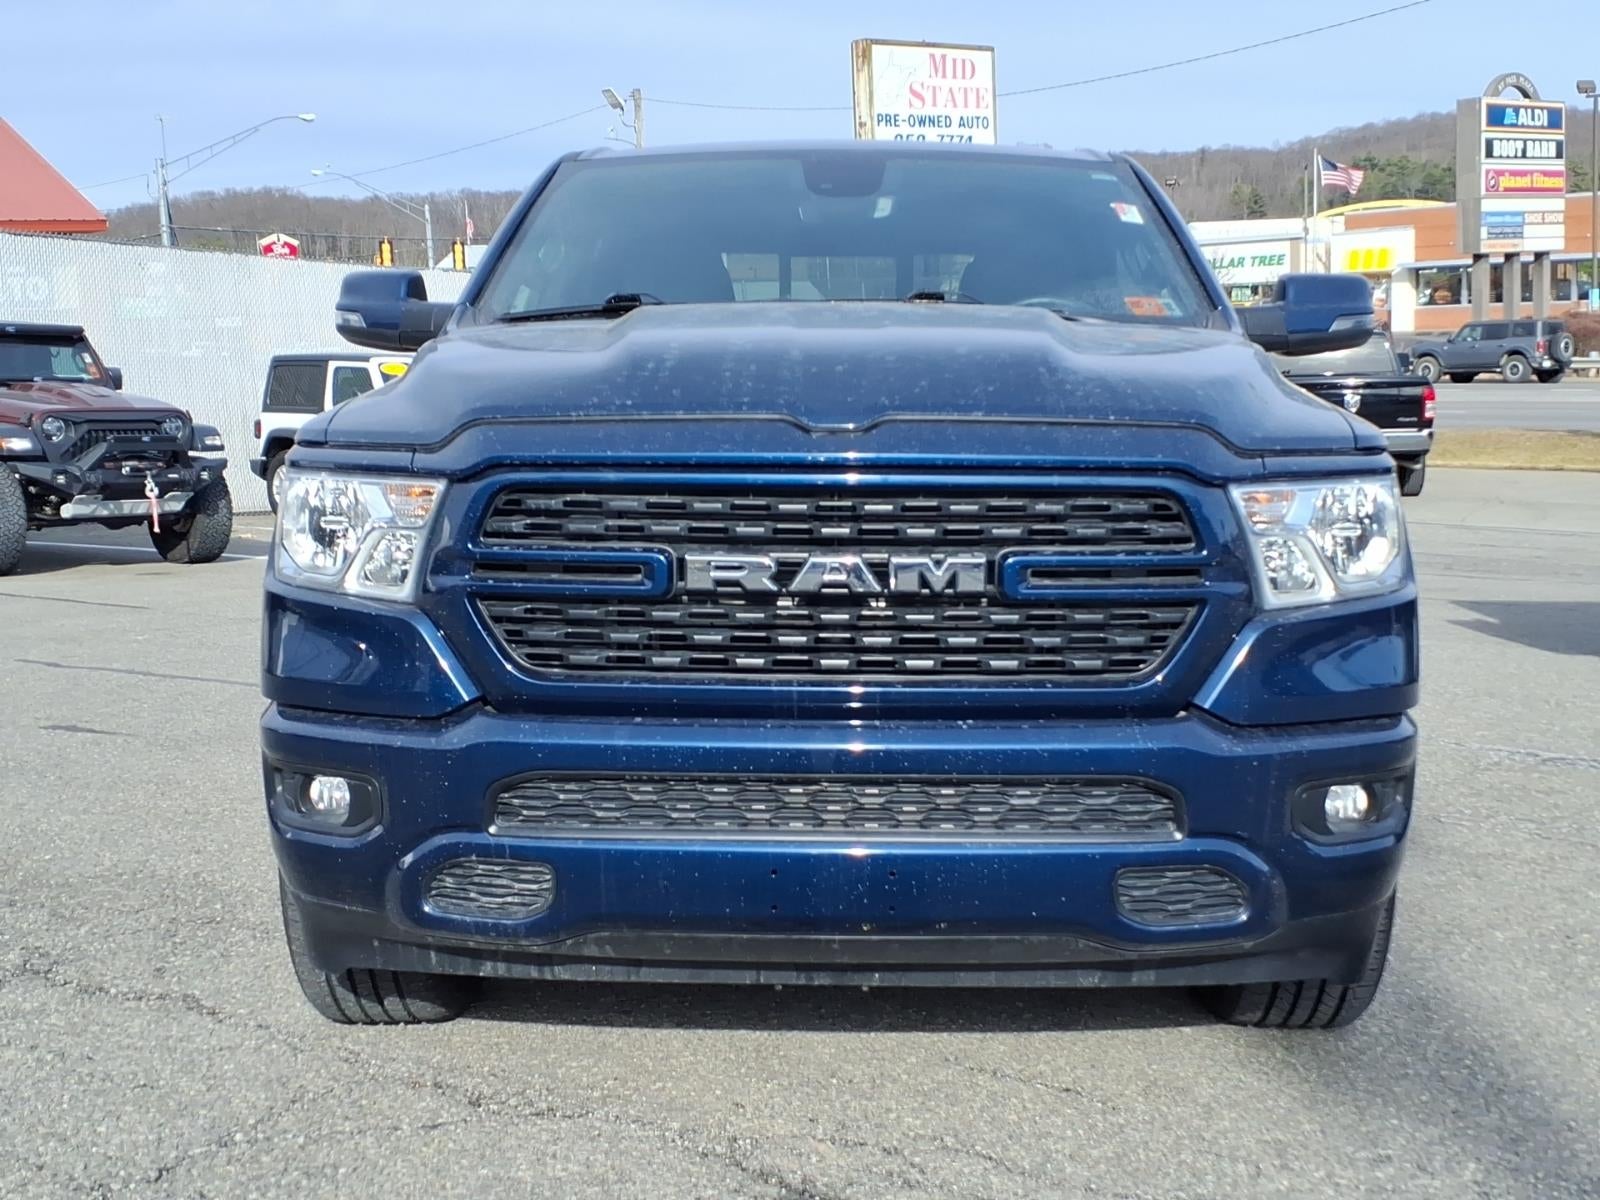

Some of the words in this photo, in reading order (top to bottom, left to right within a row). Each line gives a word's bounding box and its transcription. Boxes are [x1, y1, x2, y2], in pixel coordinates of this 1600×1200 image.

[876, 112, 952, 128] PRE-OWNED
[958, 115, 990, 130] AUTO
[1517, 107, 1548, 127] ALDI
[1492, 139, 1524, 158] BOOT
[1526, 140, 1557, 158] BARN
[1498, 171, 1531, 191] planet
[1532, 171, 1564, 189] fitness
[1208, 256, 1246, 270] LLAR
[1250, 253, 1286, 267] TREE
[684, 553, 987, 593] RAM
